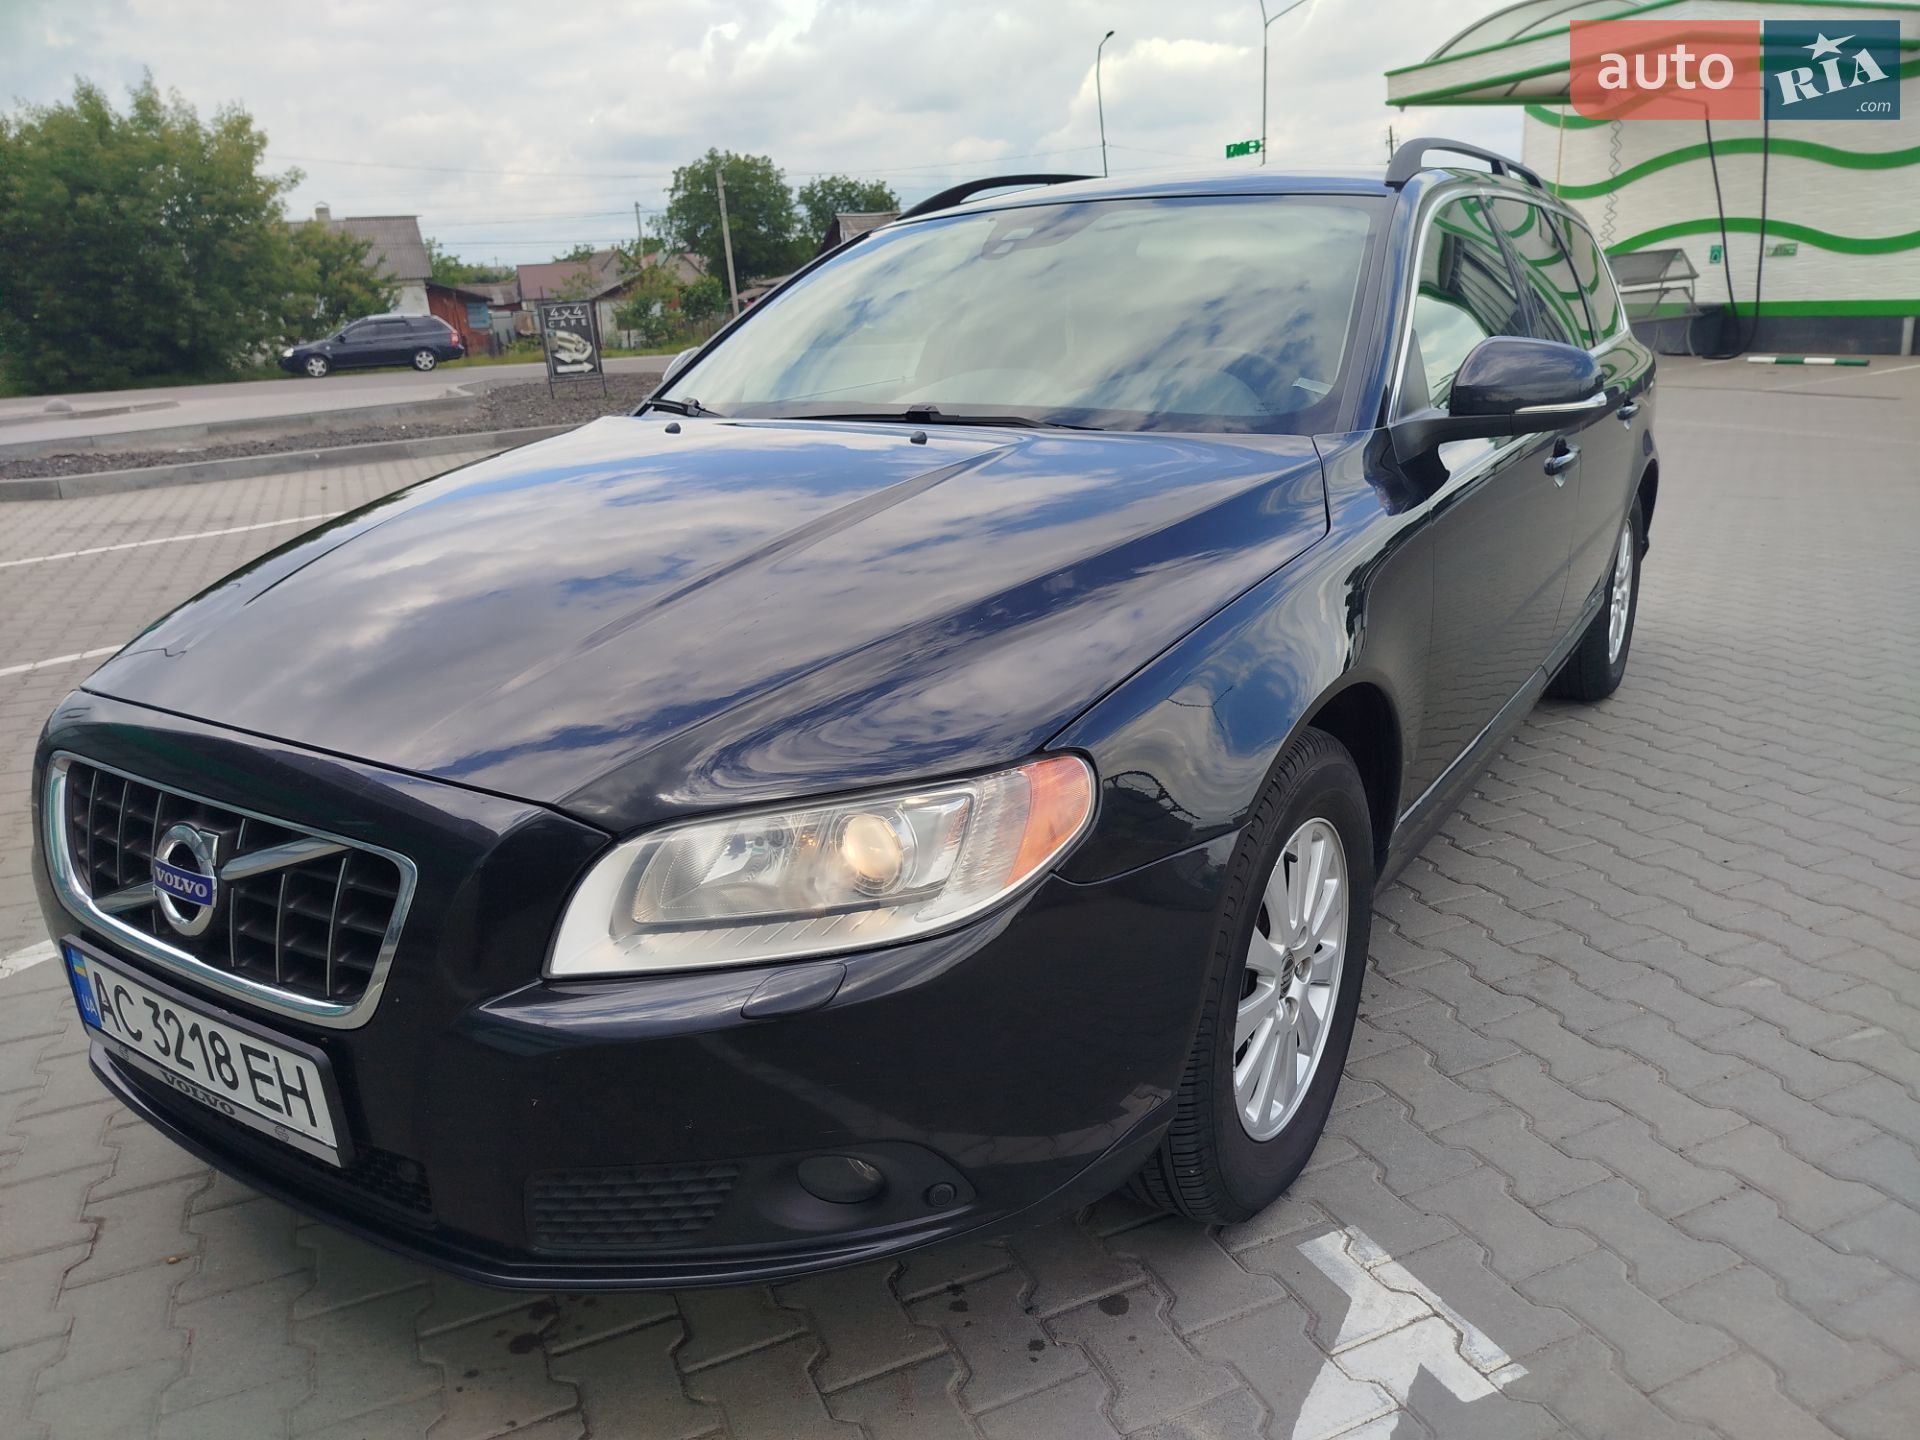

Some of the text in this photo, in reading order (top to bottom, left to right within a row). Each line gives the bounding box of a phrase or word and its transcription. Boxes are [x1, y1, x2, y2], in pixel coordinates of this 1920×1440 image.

[548, 319, 588, 328] CAFE
[154, 865, 209, 899] VOLVO
[81, 993, 98, 1017] UA
[94, 971, 318, 1128] AC 3218 EH
[161, 1069, 236, 1116] VOLVO
